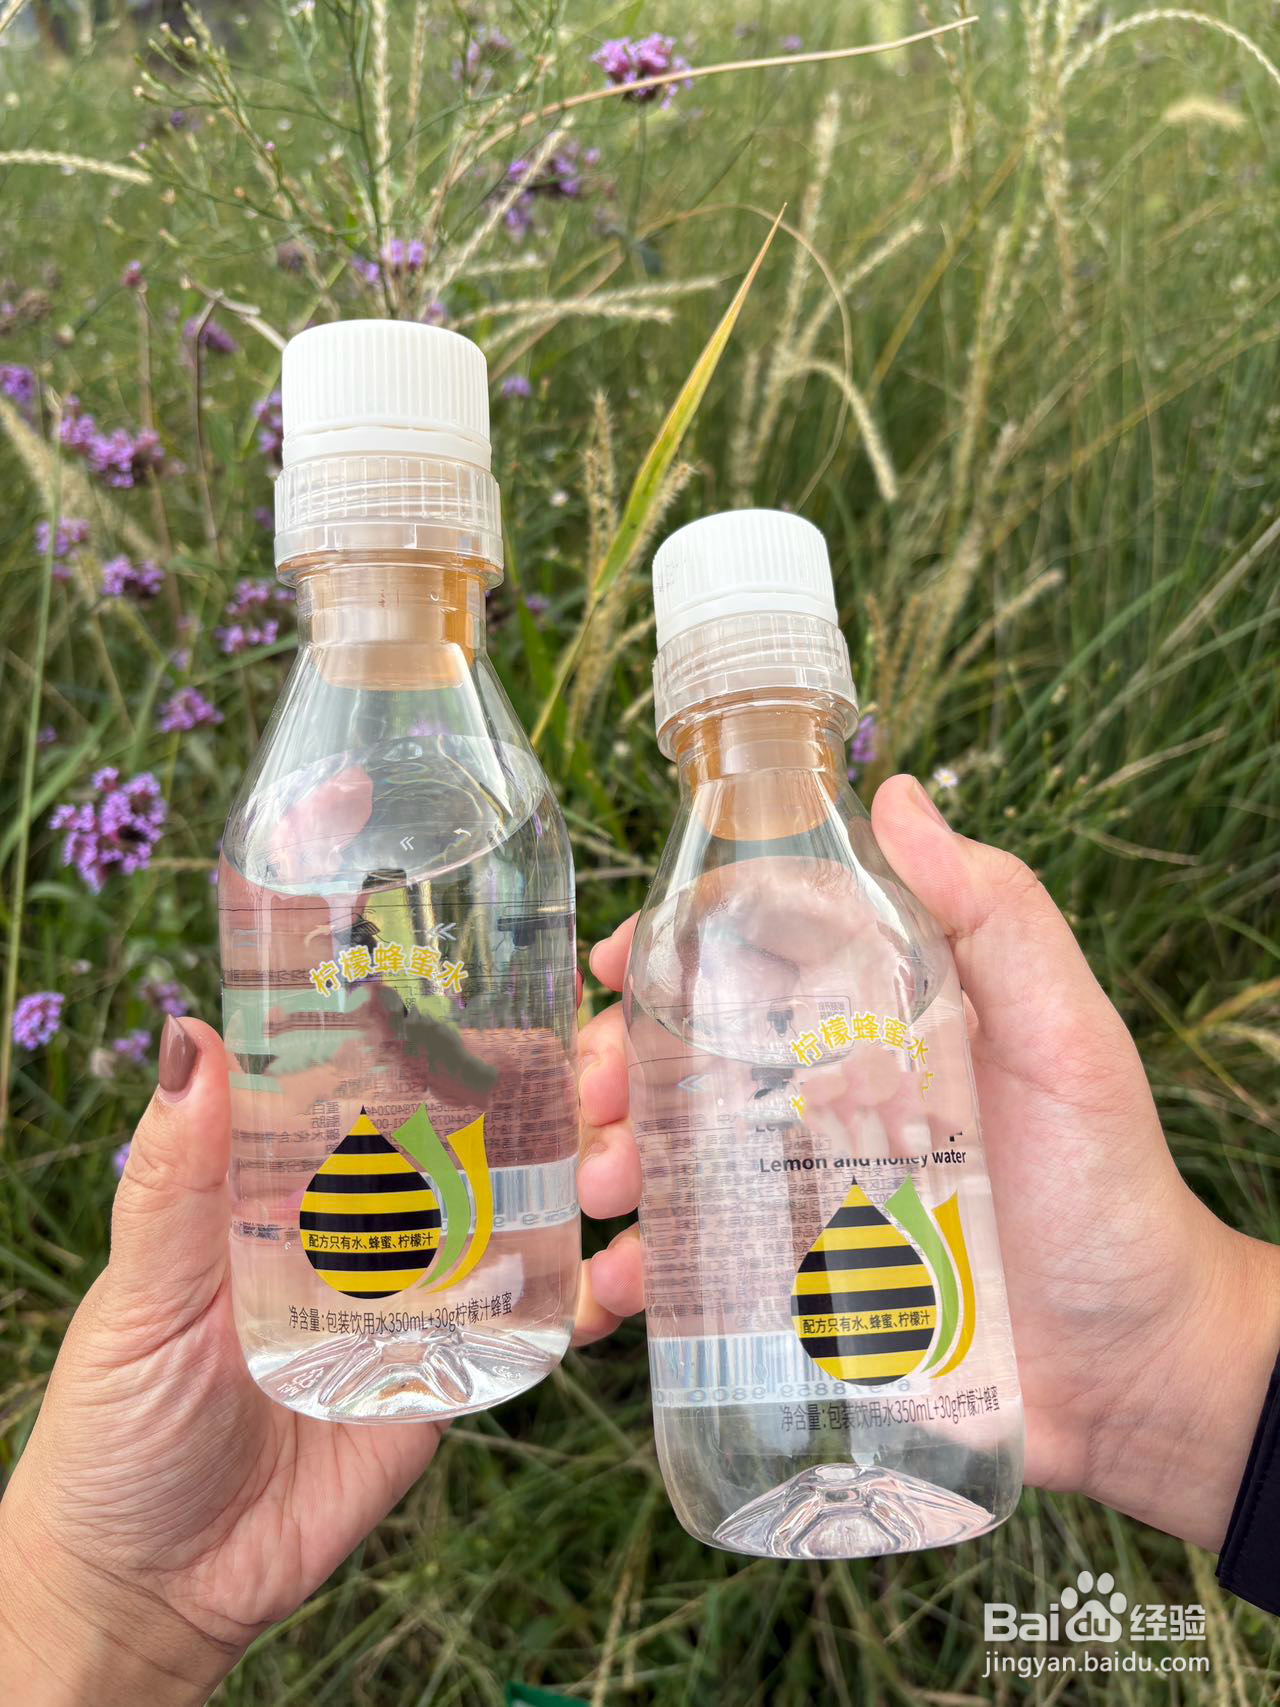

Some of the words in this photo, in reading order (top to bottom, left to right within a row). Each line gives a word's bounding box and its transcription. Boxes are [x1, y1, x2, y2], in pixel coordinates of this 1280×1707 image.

[309, 942, 469, 997] 柠檬蜂蜜水
[790, 1011, 929, 1066] 柠檬蜂蜜水
[760, 1156, 827, 1173] Lemon
[932, 1150, 966, 1164] water
[308, 1232, 434, 1251] 配方只有水、蜂蜜、柠檬汁
[802, 1309, 931, 1335] 配方只有水、蜂蜜、柠檬汁
